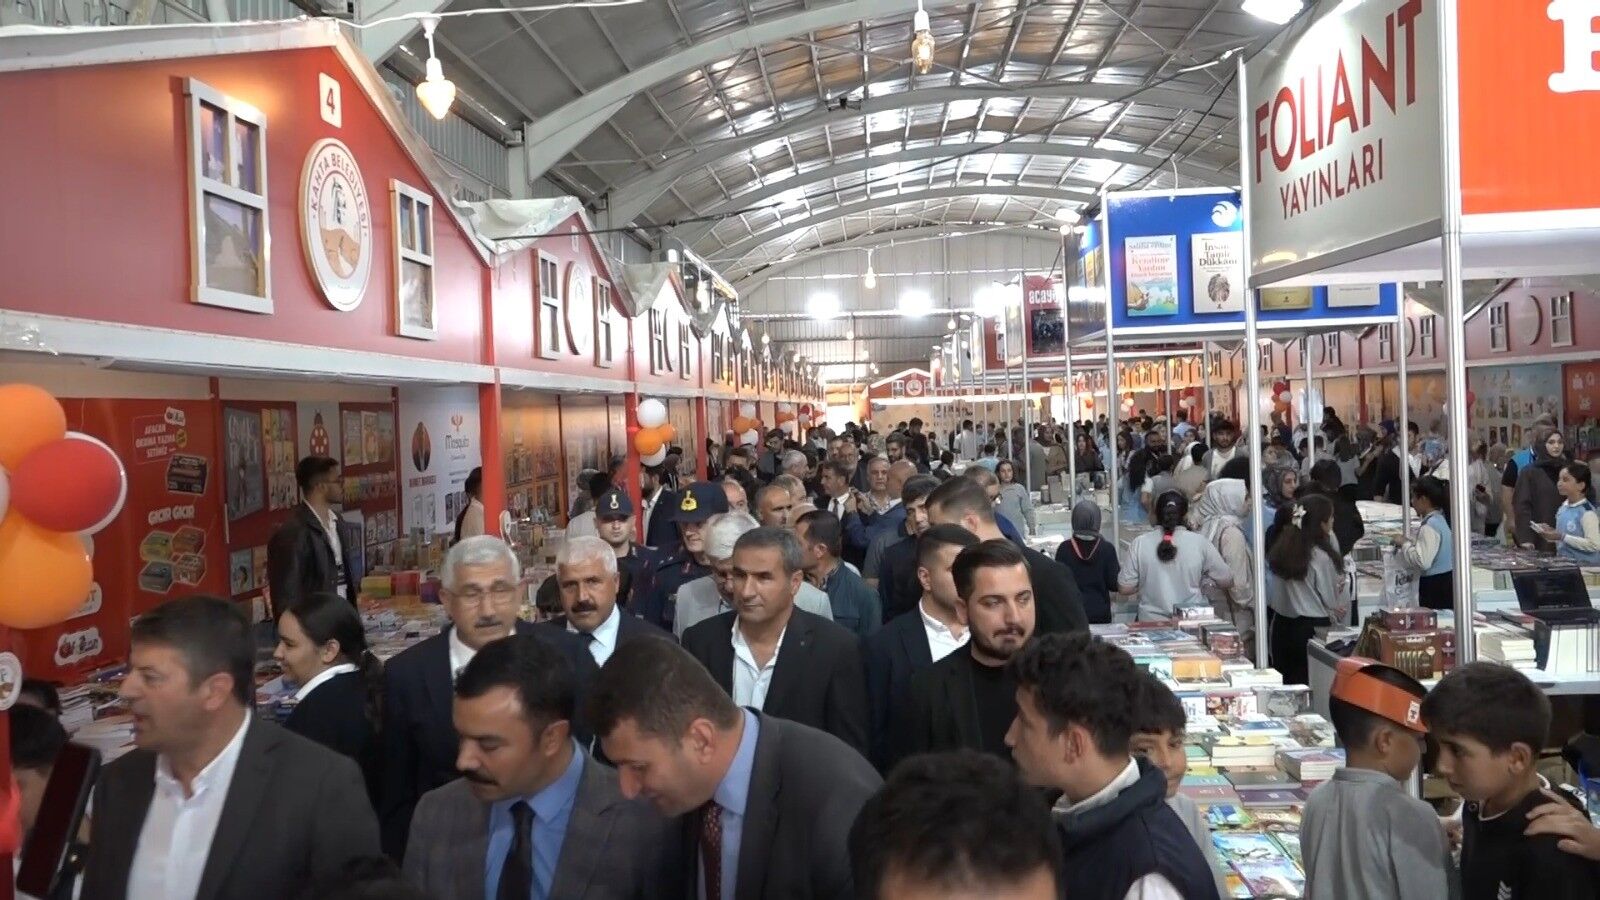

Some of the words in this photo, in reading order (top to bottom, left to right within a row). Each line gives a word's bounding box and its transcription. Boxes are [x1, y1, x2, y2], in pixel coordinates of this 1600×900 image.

[325, 87, 337, 115] 4
[1256, 0, 1422, 184] FOLIANT
[311, 156, 331, 212] KAHTA
[1280, 138, 1383, 220] YAYINLARI
